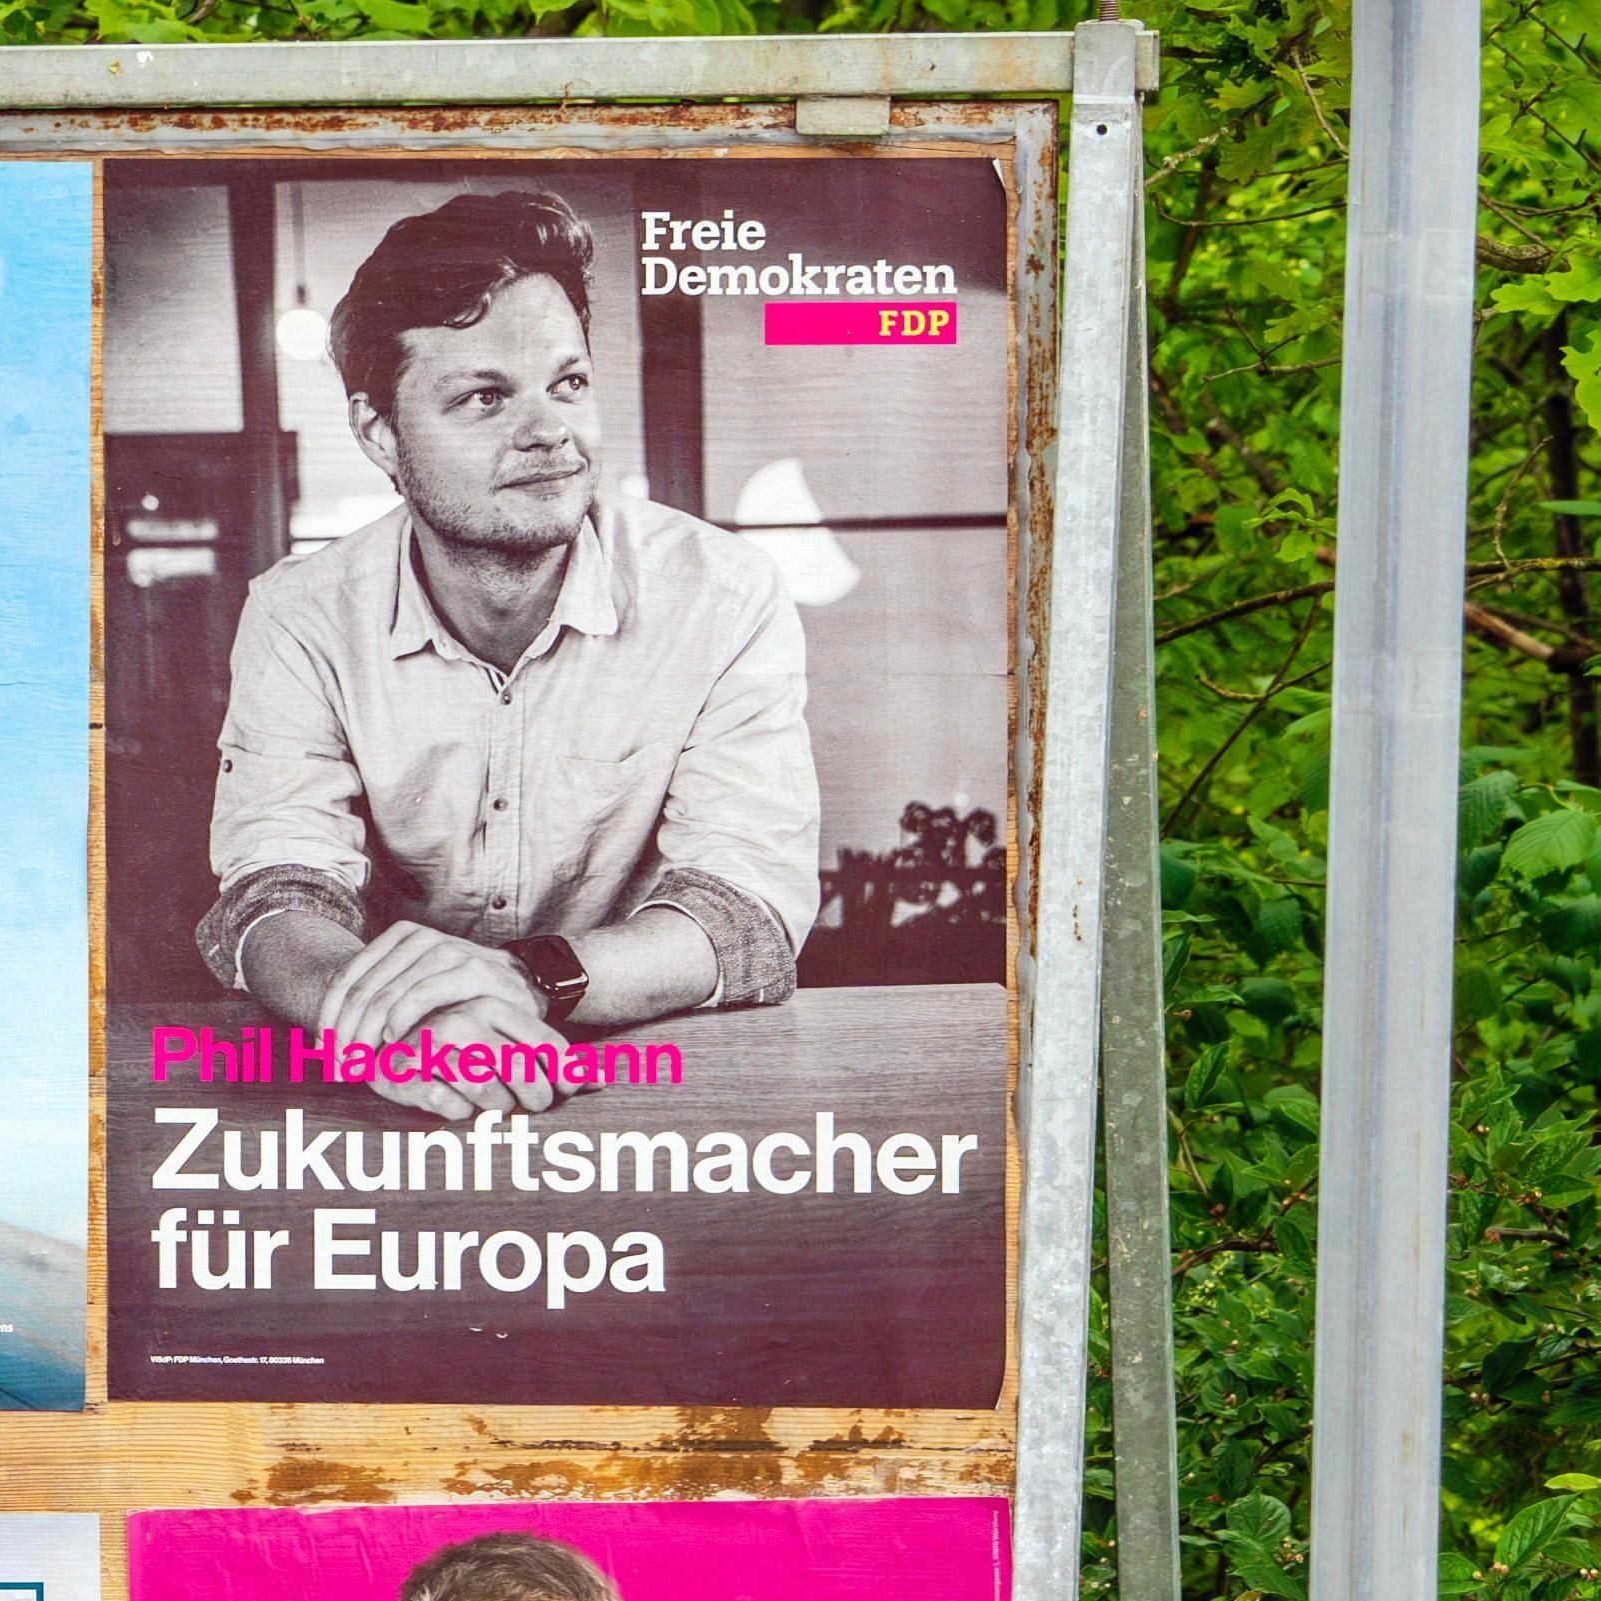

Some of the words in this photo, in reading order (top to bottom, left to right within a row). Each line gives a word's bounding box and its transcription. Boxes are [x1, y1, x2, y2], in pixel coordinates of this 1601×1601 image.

[642, 210, 766, 252] Freie
[642, 255, 957, 297] Demokraten
[879, 309, 950, 338] FDP
[152, 1025, 273, 1084] Phil
[290, 1027, 683, 1085] Hackemann
[152, 1107, 978, 1195] Zukunftsmacher
[152, 1207, 289, 1291] für
[313, 1209, 666, 1310] Europa
